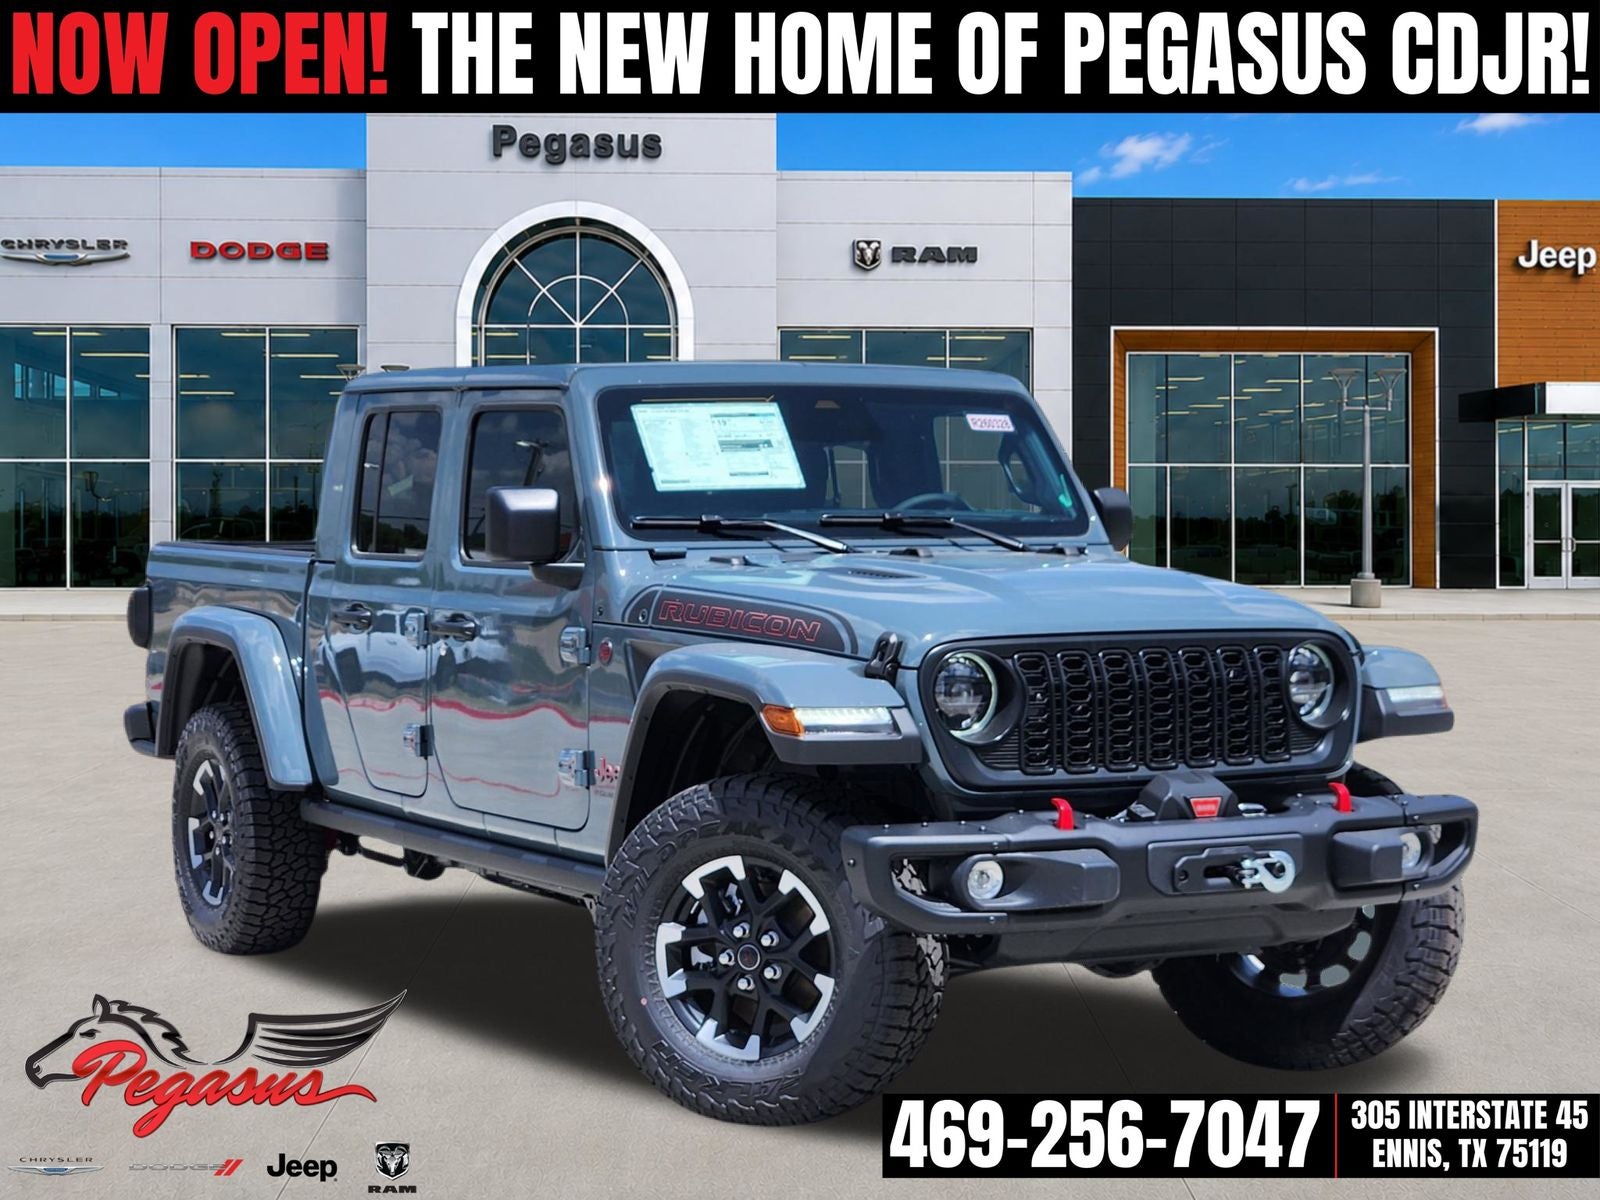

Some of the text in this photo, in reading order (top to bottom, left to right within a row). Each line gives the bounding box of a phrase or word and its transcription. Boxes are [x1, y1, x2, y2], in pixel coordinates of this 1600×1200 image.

[492, 124, 663, 165] Pegasus
[0, 238, 129, 251] CHRYSLER
[190, 241, 330, 261] DODGE
[891, 246, 978, 263] RAM
[1518, 239, 1597, 275] Jeep
[658, 600, 821, 642] RUBICON
